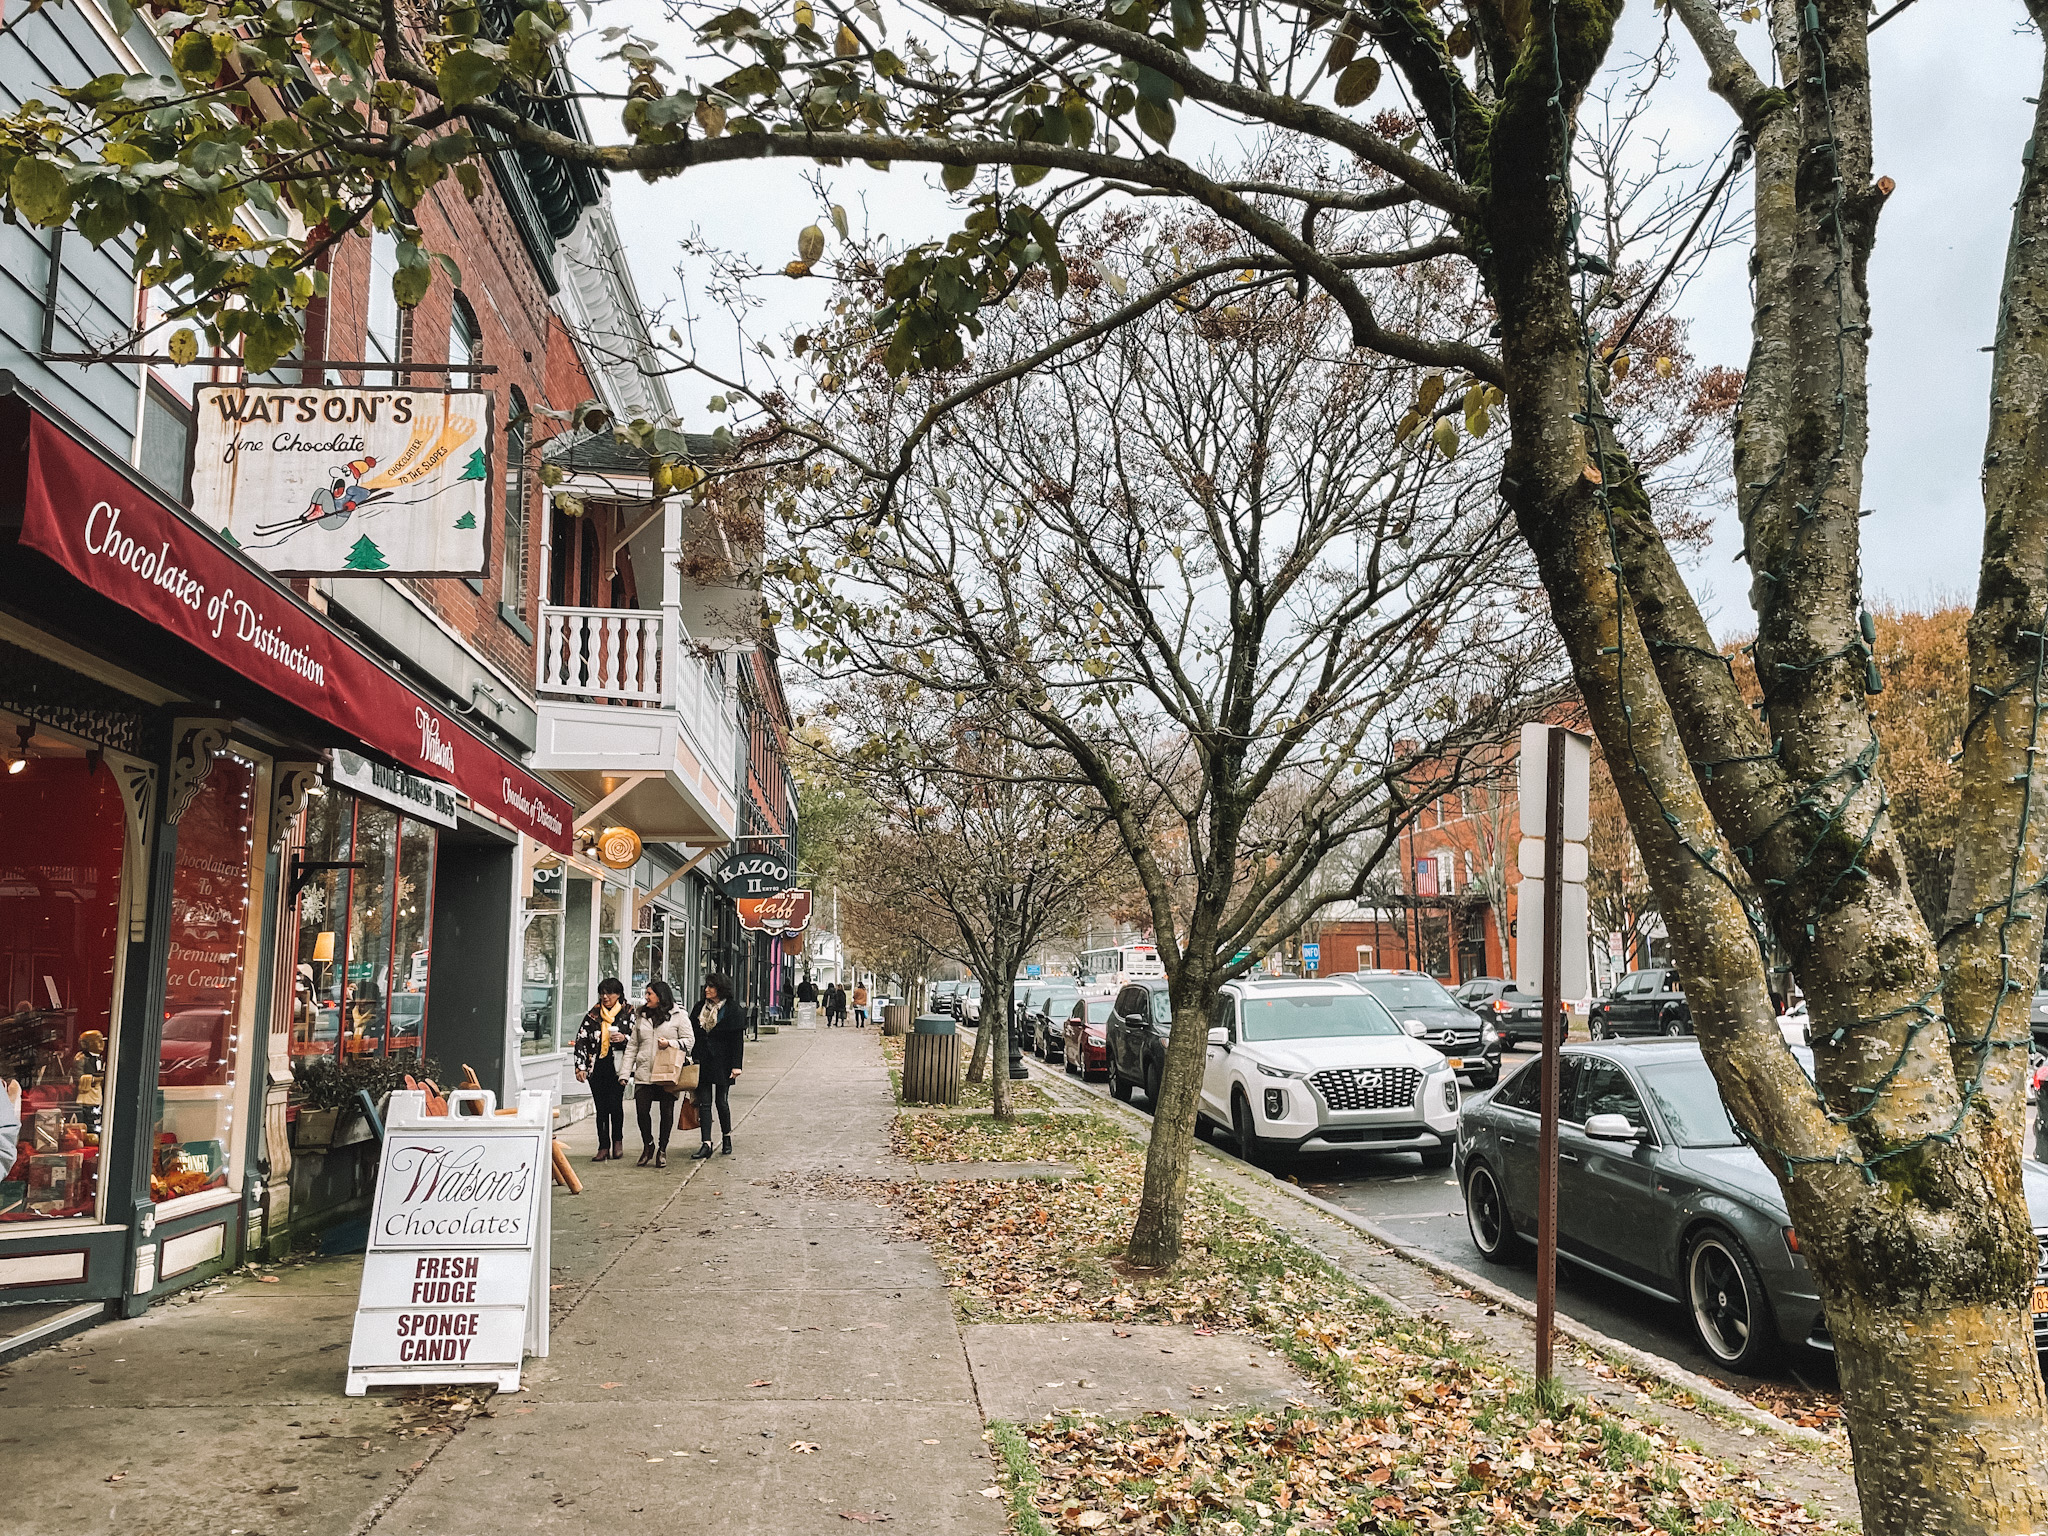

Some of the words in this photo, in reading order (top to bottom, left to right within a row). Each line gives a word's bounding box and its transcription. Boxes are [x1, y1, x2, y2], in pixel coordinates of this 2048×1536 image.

[210, 394, 412, 424] WATSON'S
[223, 432, 264, 463] fine
[272, 432, 364, 452] Chocolate
[387, 438, 423, 476] CHOCOLATIER
[398, 476, 409, 484] TO
[407, 467, 424, 480] THE
[421, 446, 448, 471] SLOPES
[84, 501, 204, 610] Chocolates
[207, 588, 233, 638] of
[234, 600, 325, 687] Distinction
[502, 776, 530, 816] Chocolates
[530, 797, 539, 826] of
[537, 800, 562, 836] Distinction
[718, 860, 788, 883] KAZOO
[199, 877, 212, 895] To
[747, 879, 762, 893] II
[753, 898, 795, 918] daff
[167, 942, 230, 964] Premium
[1303, 947, 1318, 957] INFO
[188, 969, 231, 987] Cream
[391, 1145, 530, 1204] Watson's
[385, 1207, 521, 1236] Chocolates
[415, 1257, 479, 1279] FRESH
[411, 1281, 477, 1303] FUDGE
[397, 1313, 479, 1336] SPONGE
[400, 1338, 471, 1362] CANDY
